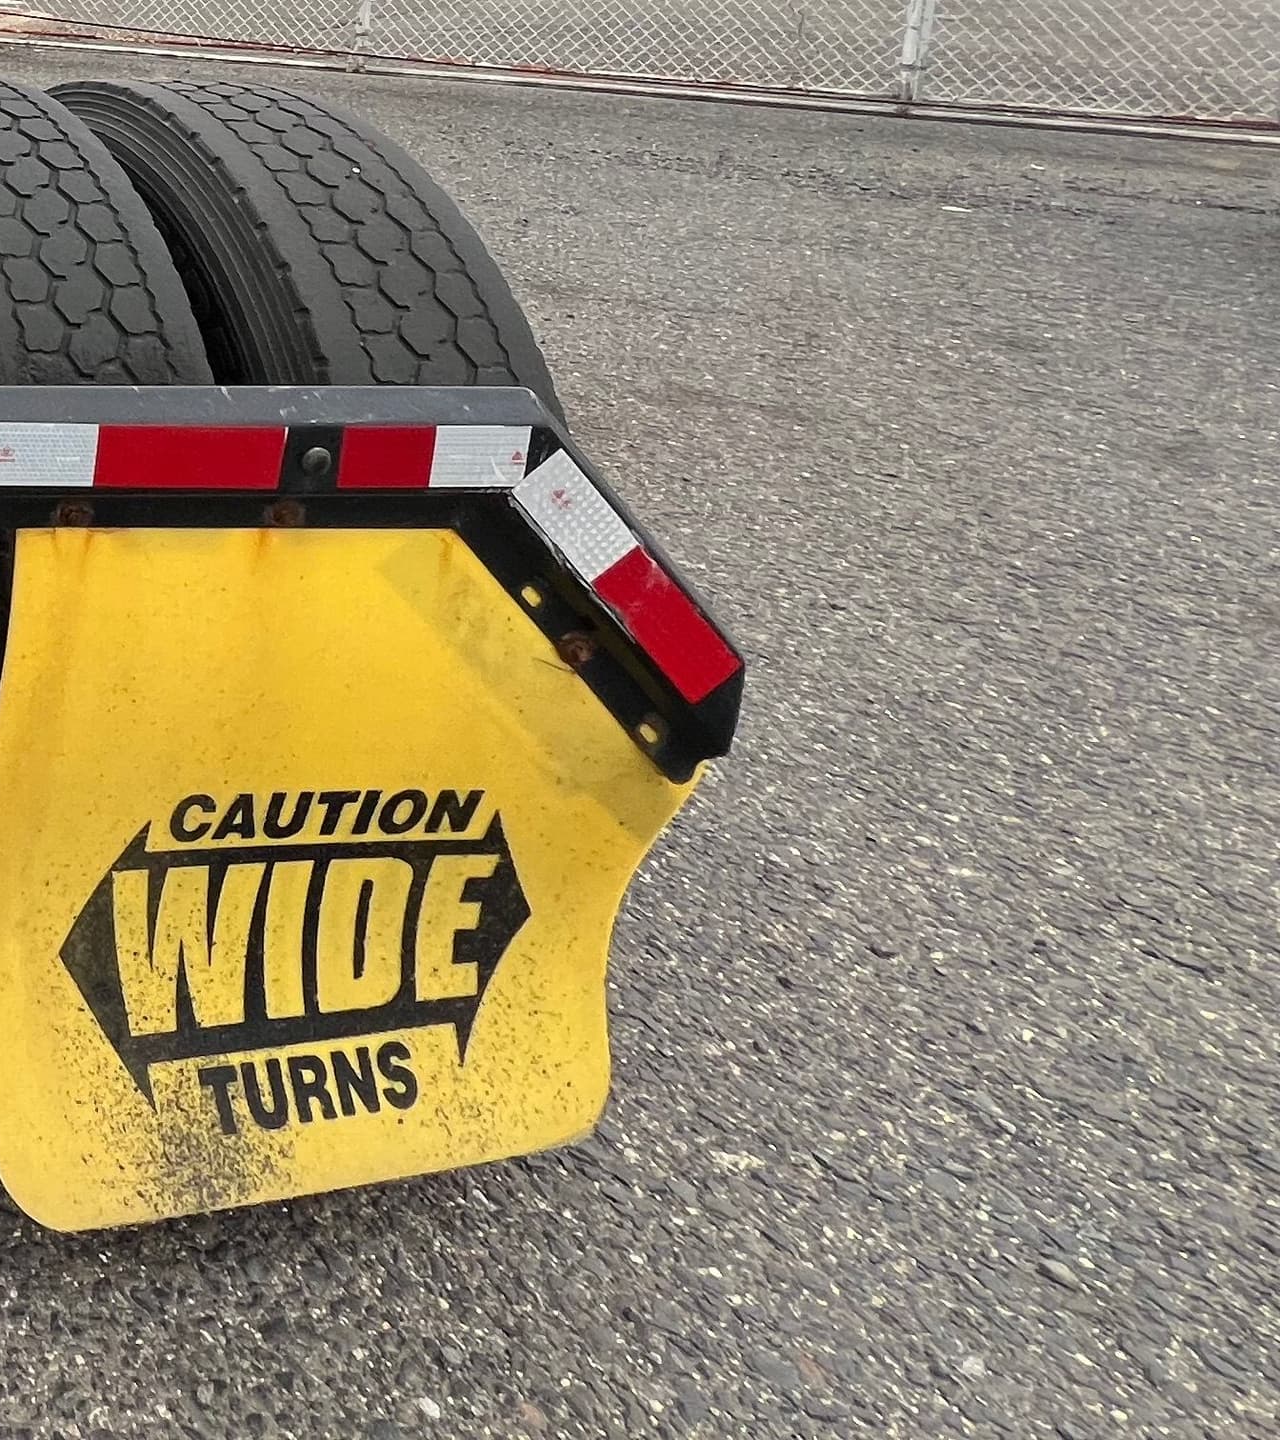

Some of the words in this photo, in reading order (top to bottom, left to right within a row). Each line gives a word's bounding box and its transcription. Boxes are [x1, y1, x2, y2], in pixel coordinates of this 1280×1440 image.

[169, 788, 485, 840] CAUTION
[112, 854, 501, 1037] WIDE
[199, 1040, 419, 1135] TURNS
